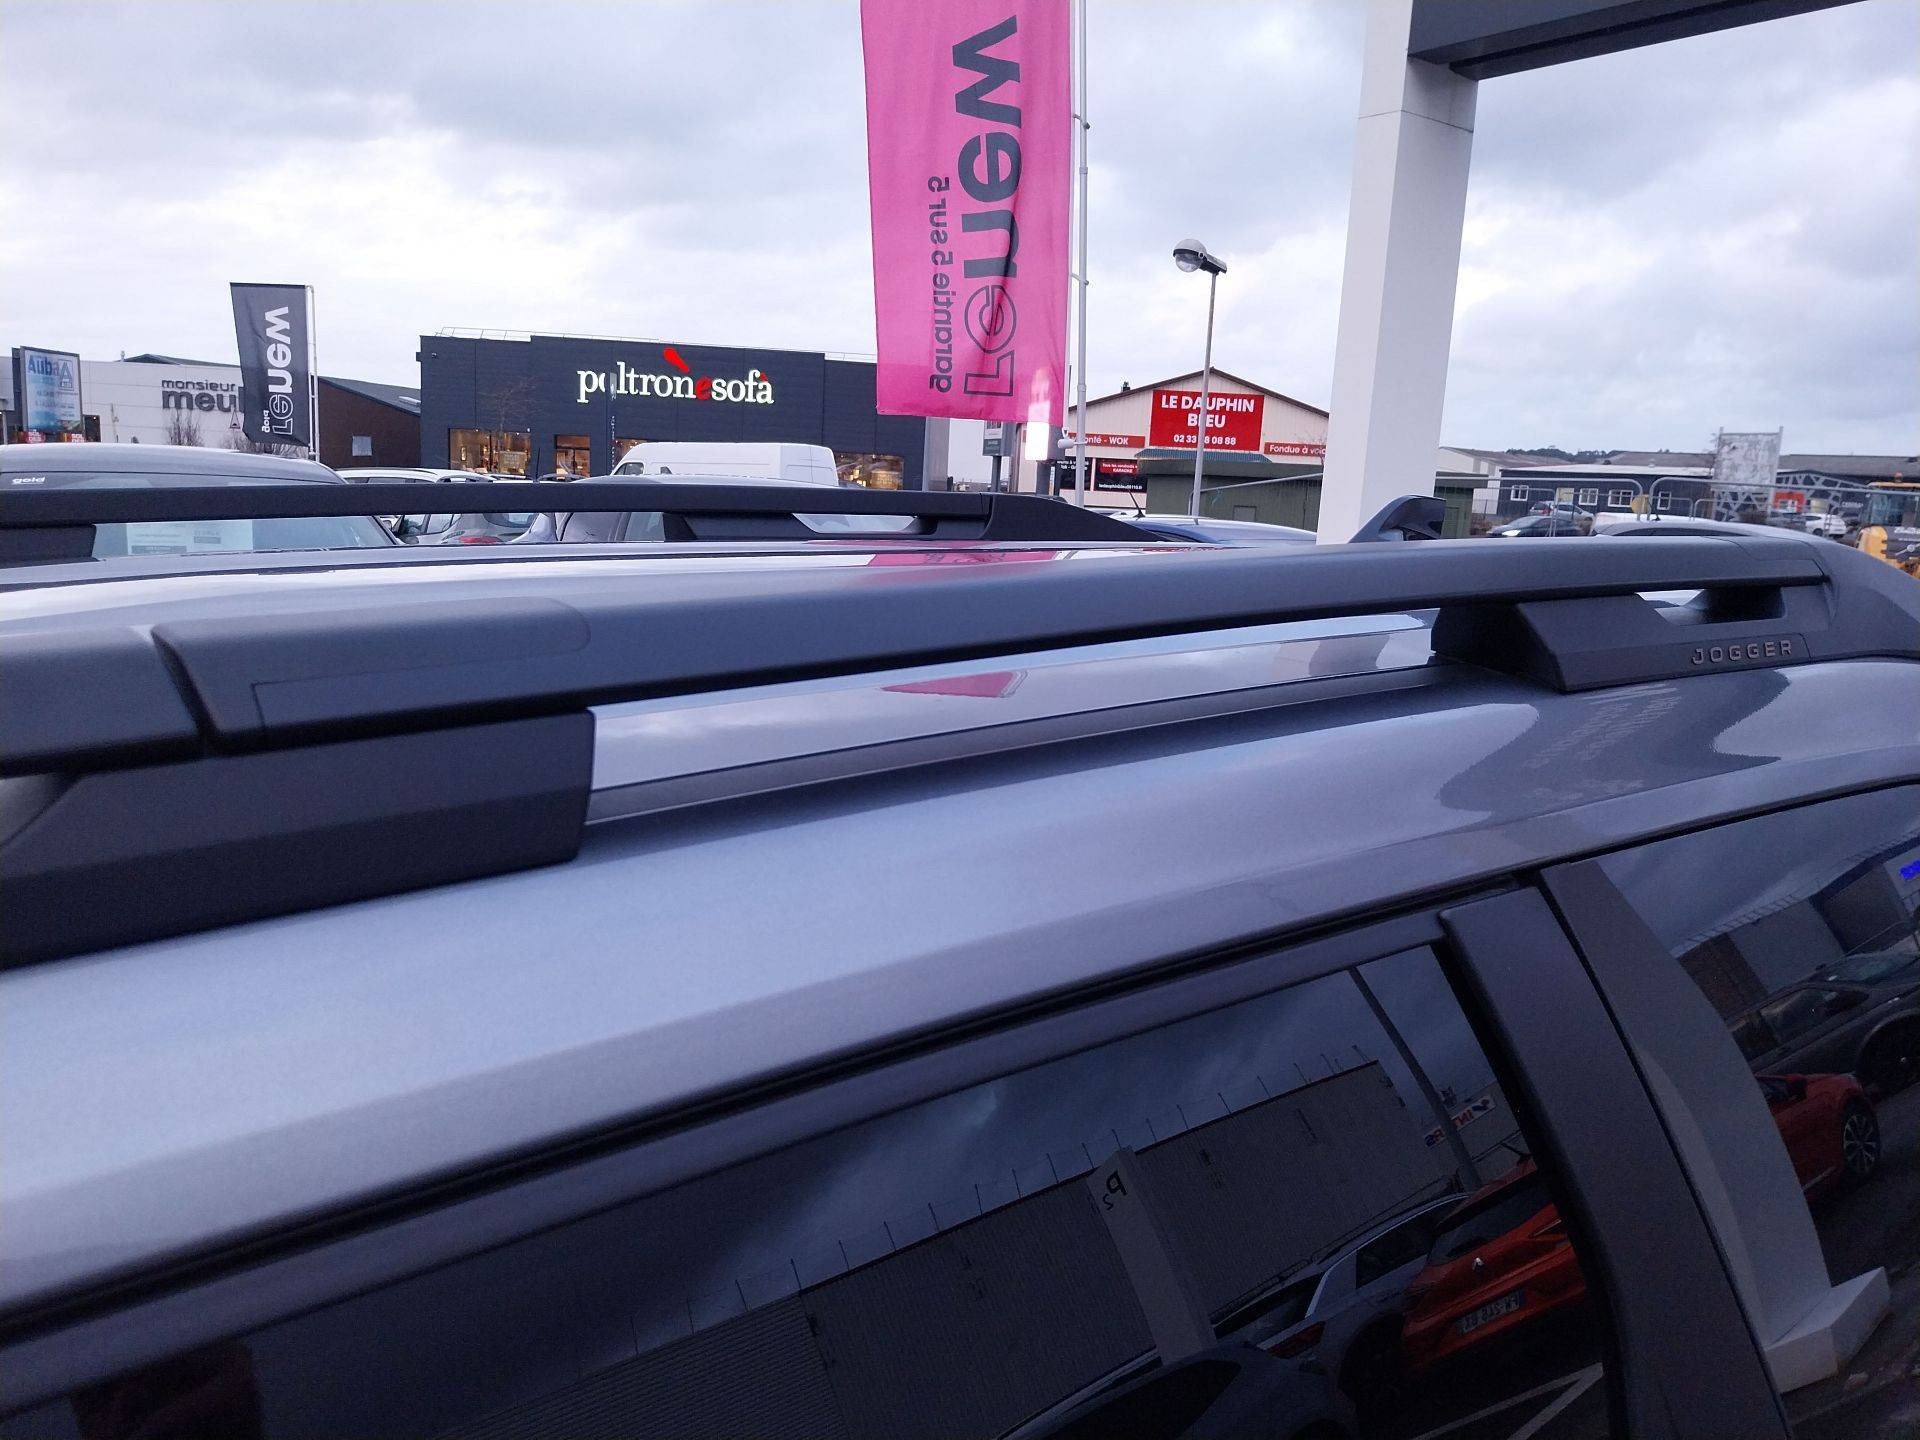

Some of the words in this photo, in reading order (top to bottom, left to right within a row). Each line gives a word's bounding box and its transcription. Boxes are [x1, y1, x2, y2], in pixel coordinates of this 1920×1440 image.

[161, 379, 236, 392] monsieur
[1161, 394, 1179, 409] LE
[1181, 395, 1255, 413] DAUPHIN
[1109, 436, 1129, 445] WOK
[1173, 434, 1185, 443] 02
[1186, 434, 1197, 443] 33
[1211, 436, 1223, 445] 08
[1224, 436, 1237, 445] 88
[1269, 444, 1300, 454] Fondue
[1692, 639, 1792, 665] JOGGER
